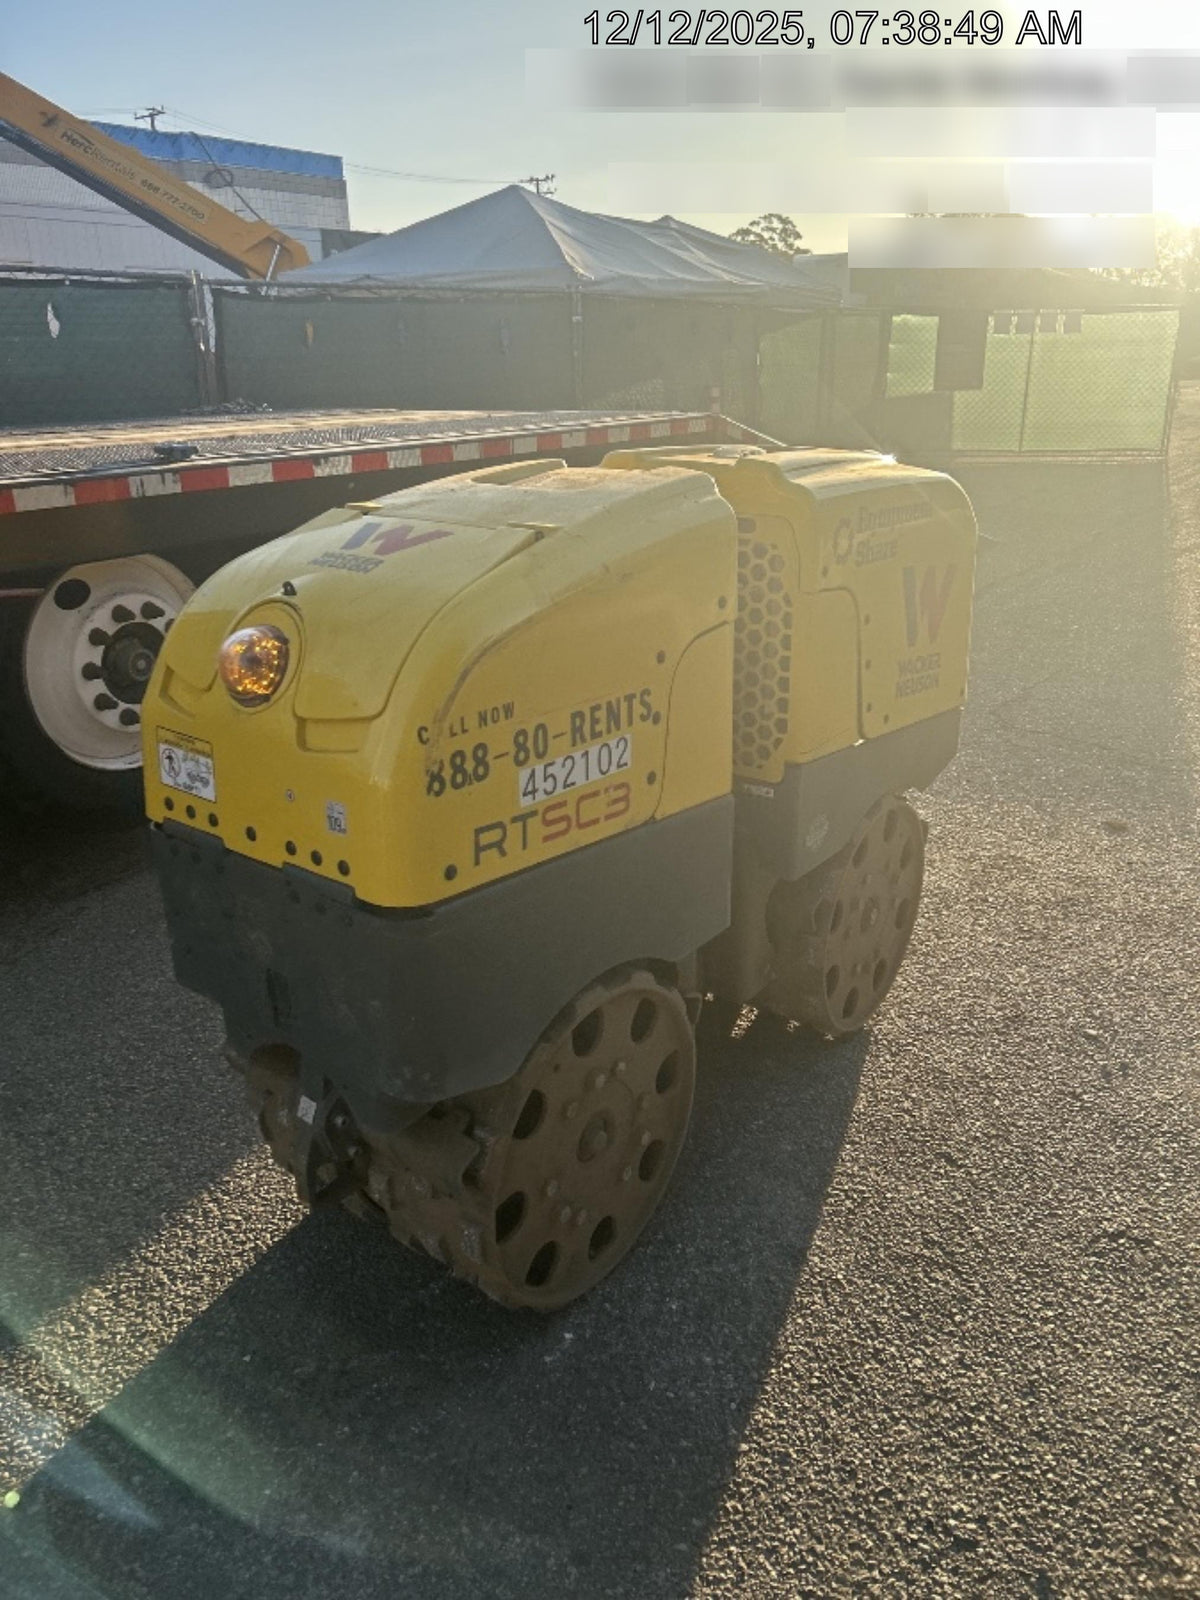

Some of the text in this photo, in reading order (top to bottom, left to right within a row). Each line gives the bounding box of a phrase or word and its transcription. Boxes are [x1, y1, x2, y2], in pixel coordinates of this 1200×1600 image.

[417, 701, 515, 745] CLL NOW
[521, 736, 630, 801] 452102
[473, 782, 631, 867] RTSC3
